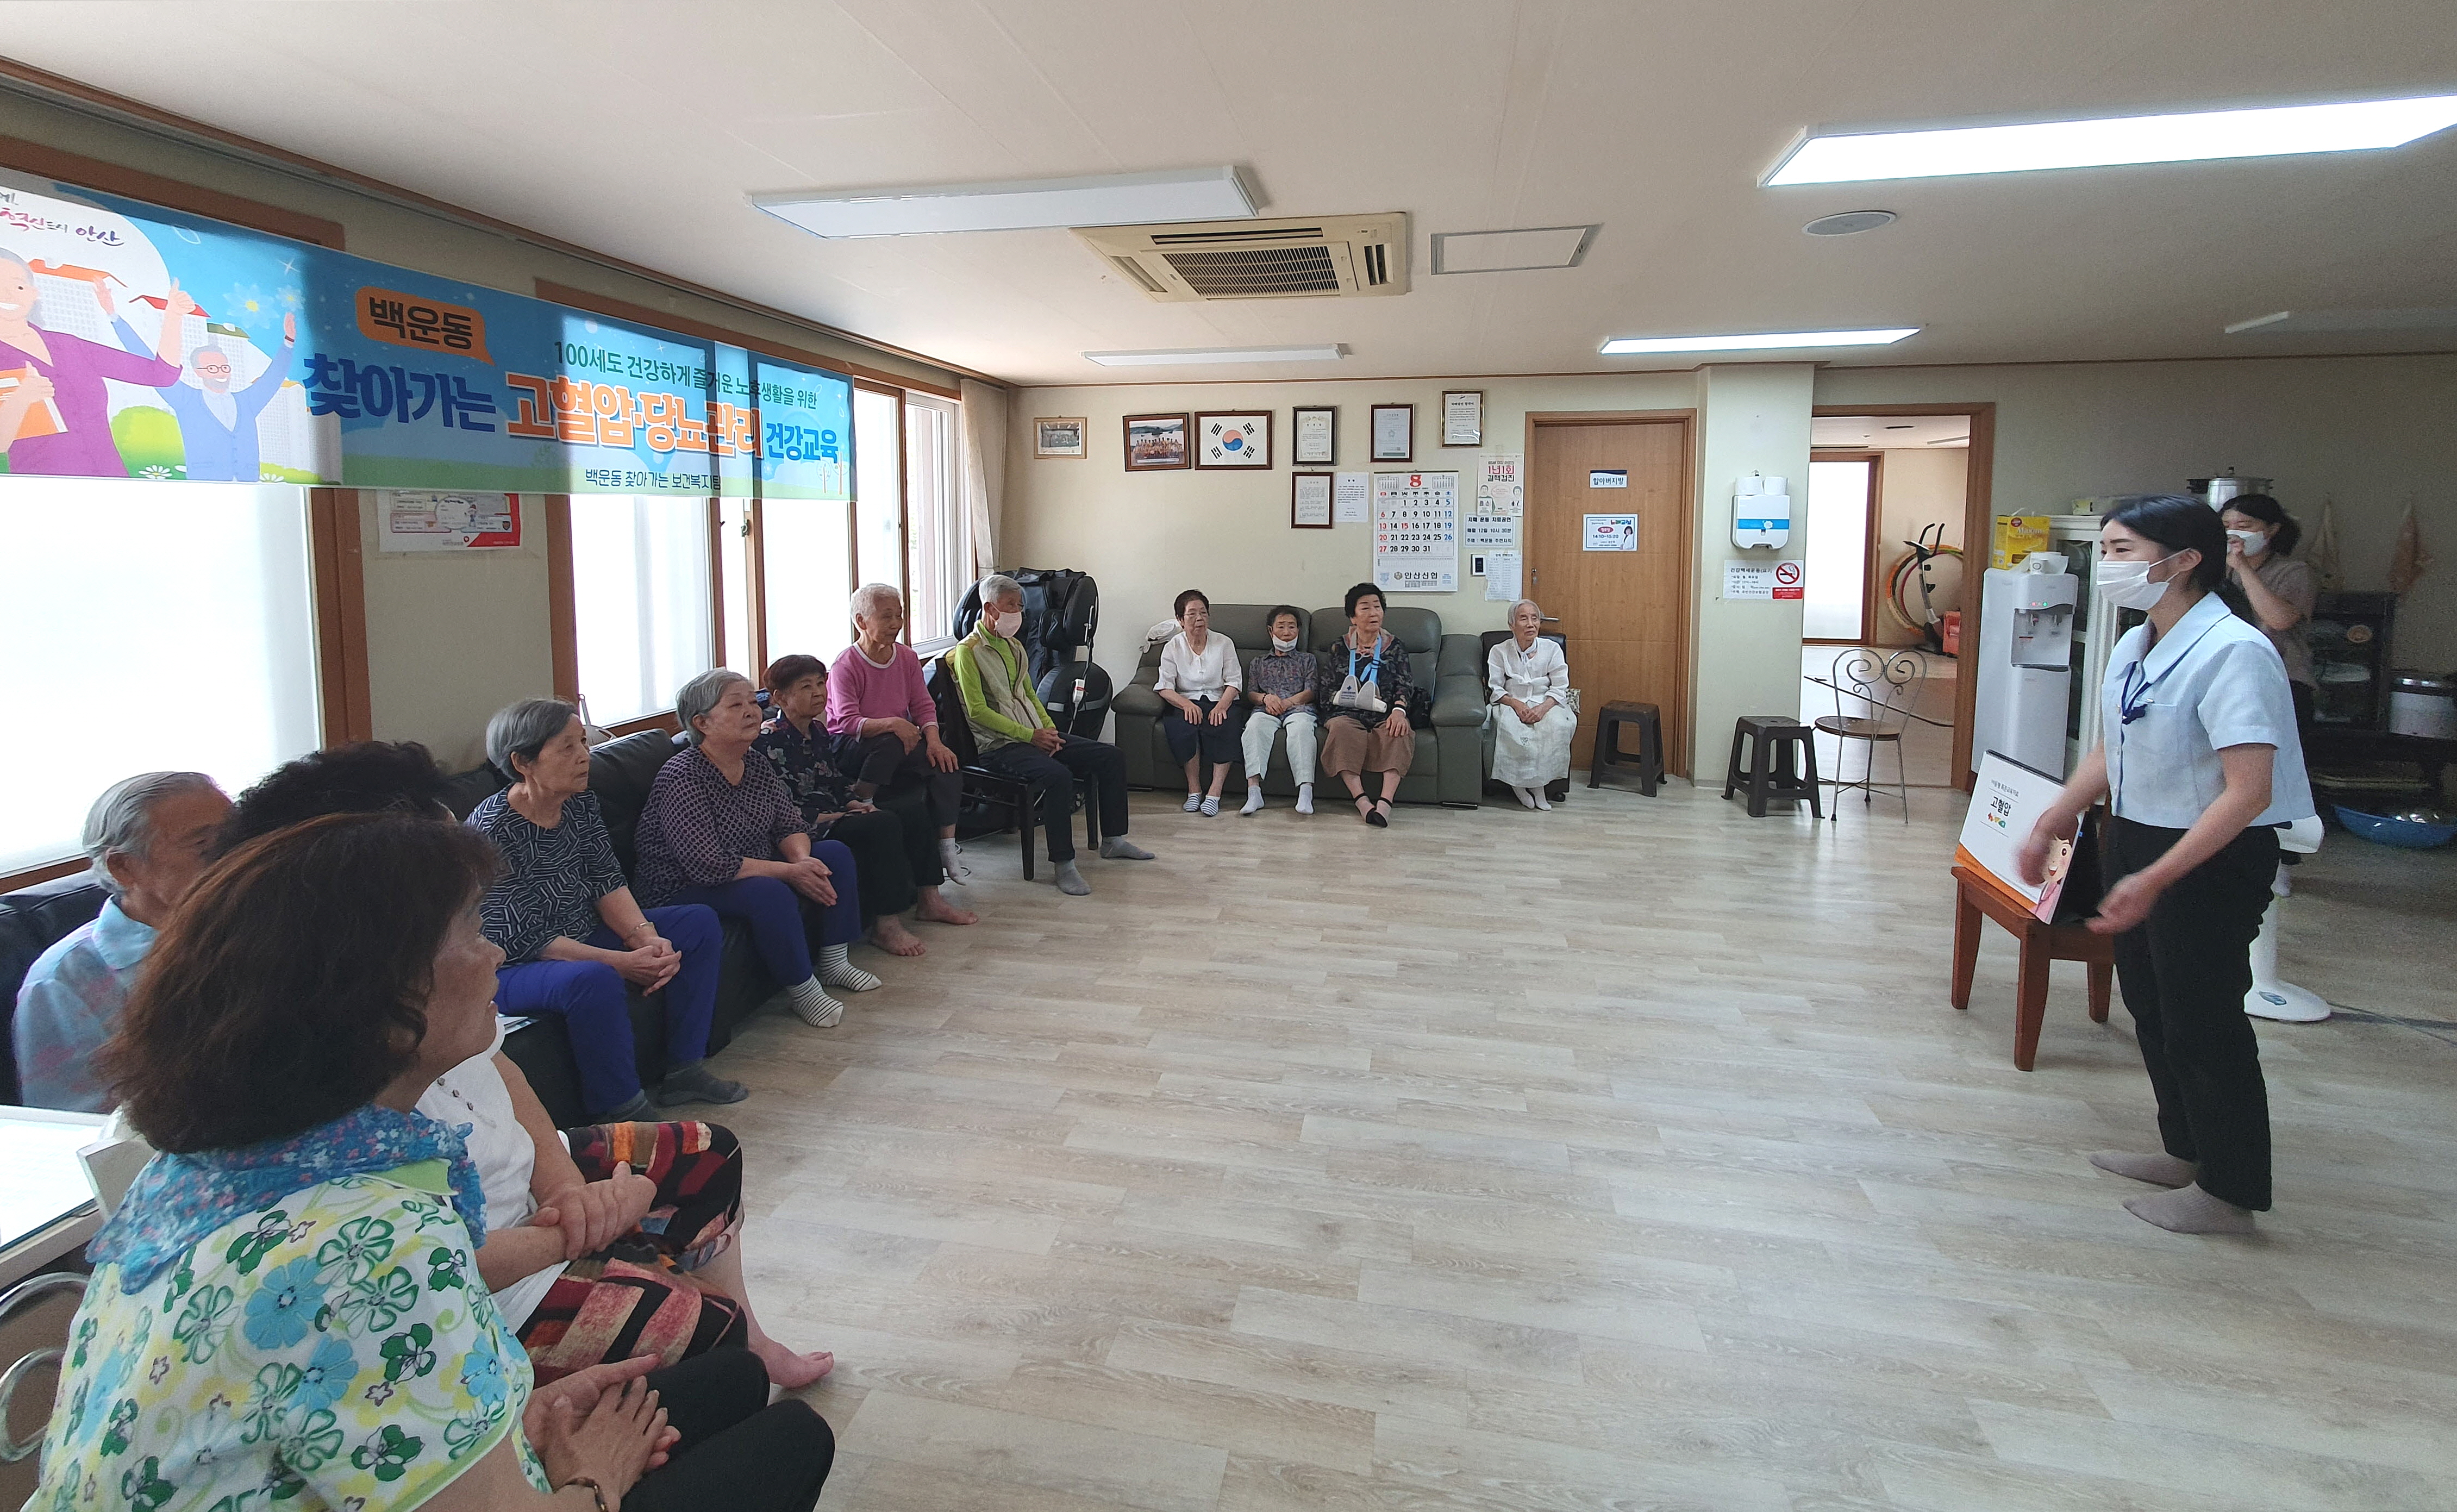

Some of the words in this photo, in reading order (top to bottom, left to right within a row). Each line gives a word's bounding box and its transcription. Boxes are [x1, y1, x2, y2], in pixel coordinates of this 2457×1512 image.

[76, 226, 124, 246] 안산
[370, 297, 473, 350] 백운동
[554, 341, 624, 373] 100세도
[627, 355, 690, 387] 건강하게
[693, 367, 733, 395] 즐거운
[735, 377, 795, 406] 노후생활을
[797, 389, 817, 410] 위한
[303, 353, 496, 433] 찾아가는
[765, 422, 839, 463] 건강교육
[585, 469, 622, 487] 백운동
[626, 471, 668, 488] 찾아가는
[672, 473, 721, 490] 보건복지팀
[1410, 474, 1422, 487] 8
[1593, 477, 1624, 485] 할아버지방
[1990, 796, 2011, 816] 고혈압
